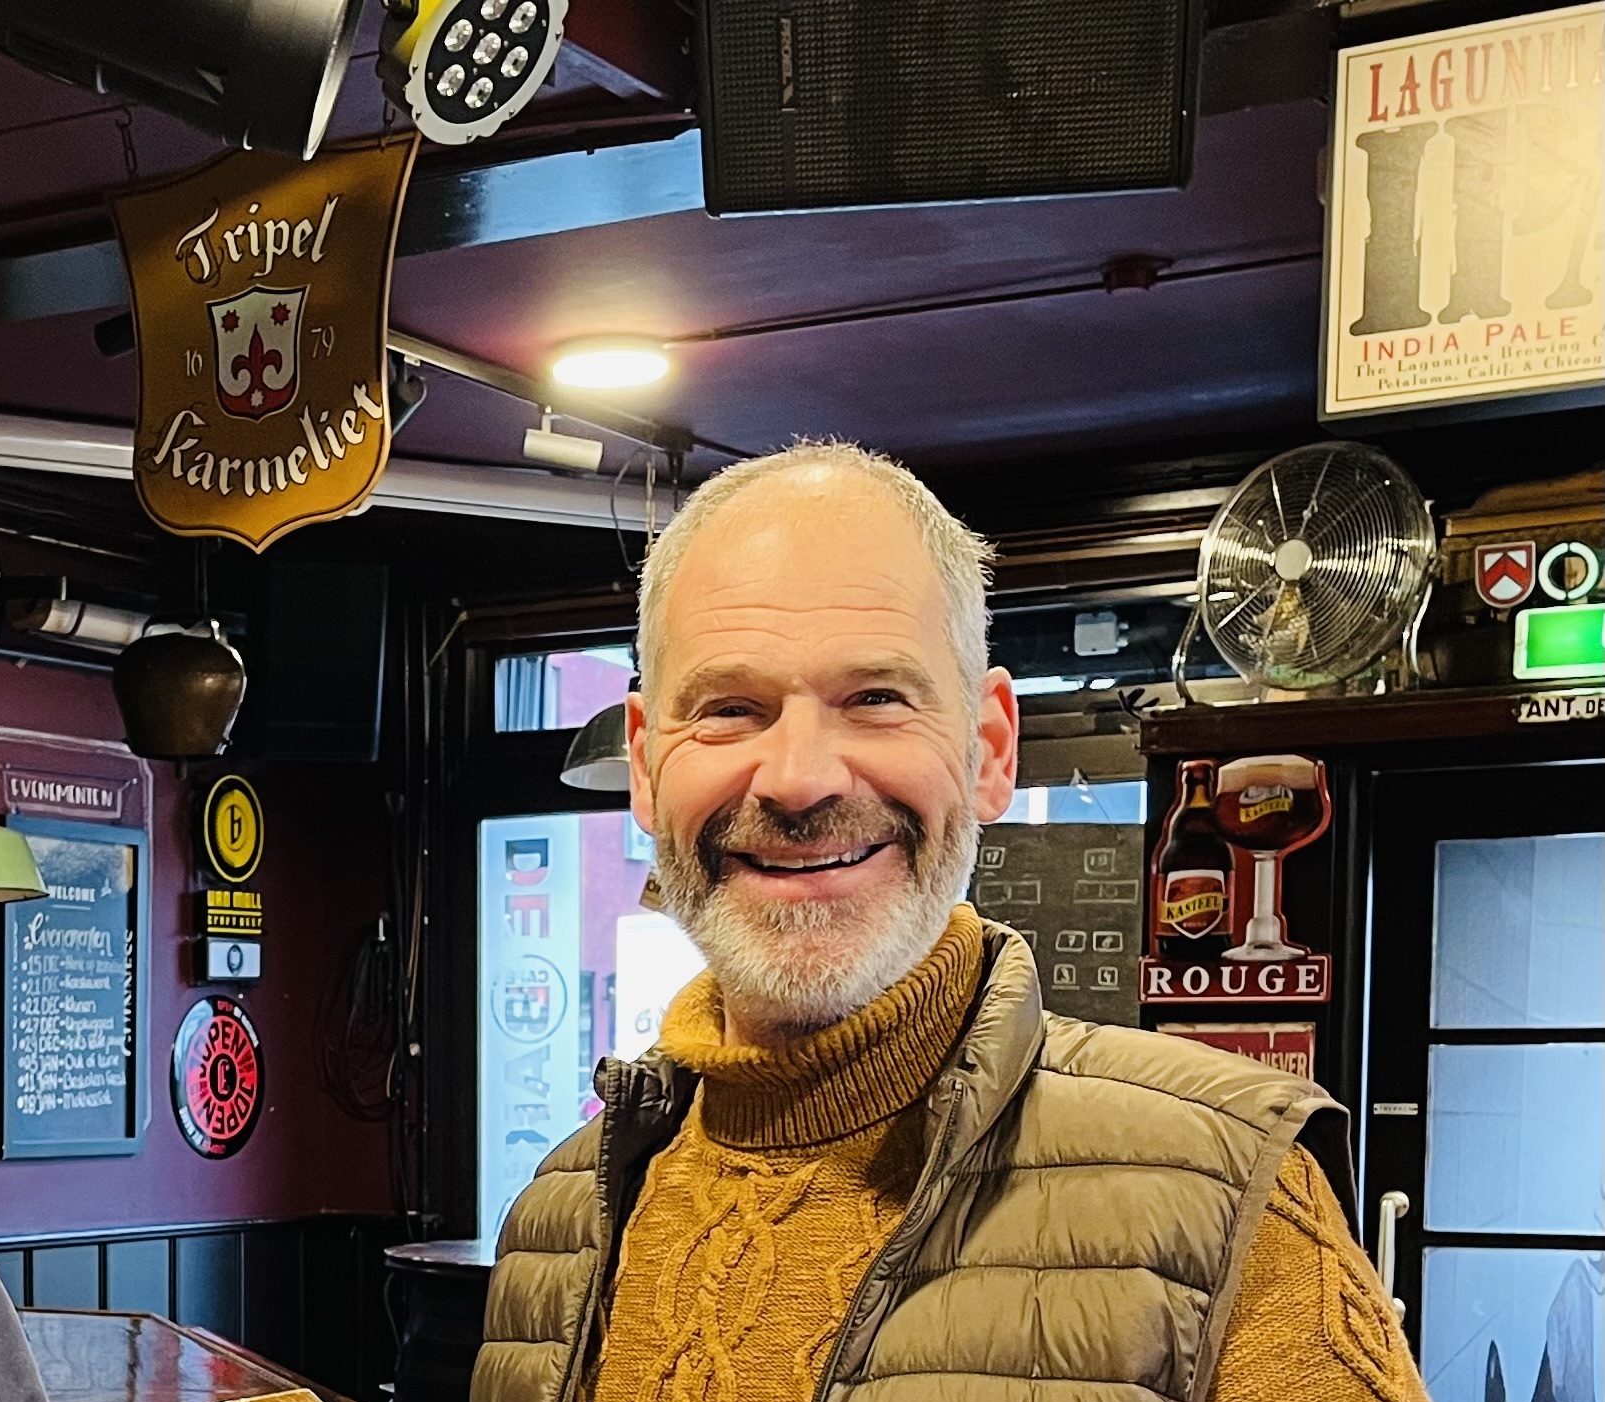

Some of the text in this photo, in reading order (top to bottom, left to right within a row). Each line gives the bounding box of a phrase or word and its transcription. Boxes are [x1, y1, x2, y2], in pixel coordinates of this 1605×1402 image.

[175, 196, 339, 279] Tripel
[184, 326, 335, 376] 16 79
[1363, 316, 1578, 362] INDIA PALE
[1354, 339, 1581, 378] The Lagunitas Brewing
[1543, 353, 1605, 370] Chicag
[152, 383, 386, 496] Karmeliet
[11, 778, 113, 807] EVENEMENTEN
[47, 885, 96, 903] WELCOME
[1166, 896, 1221, 920] KASTEEL
[1148, 965, 1321, 995] ROUGE
